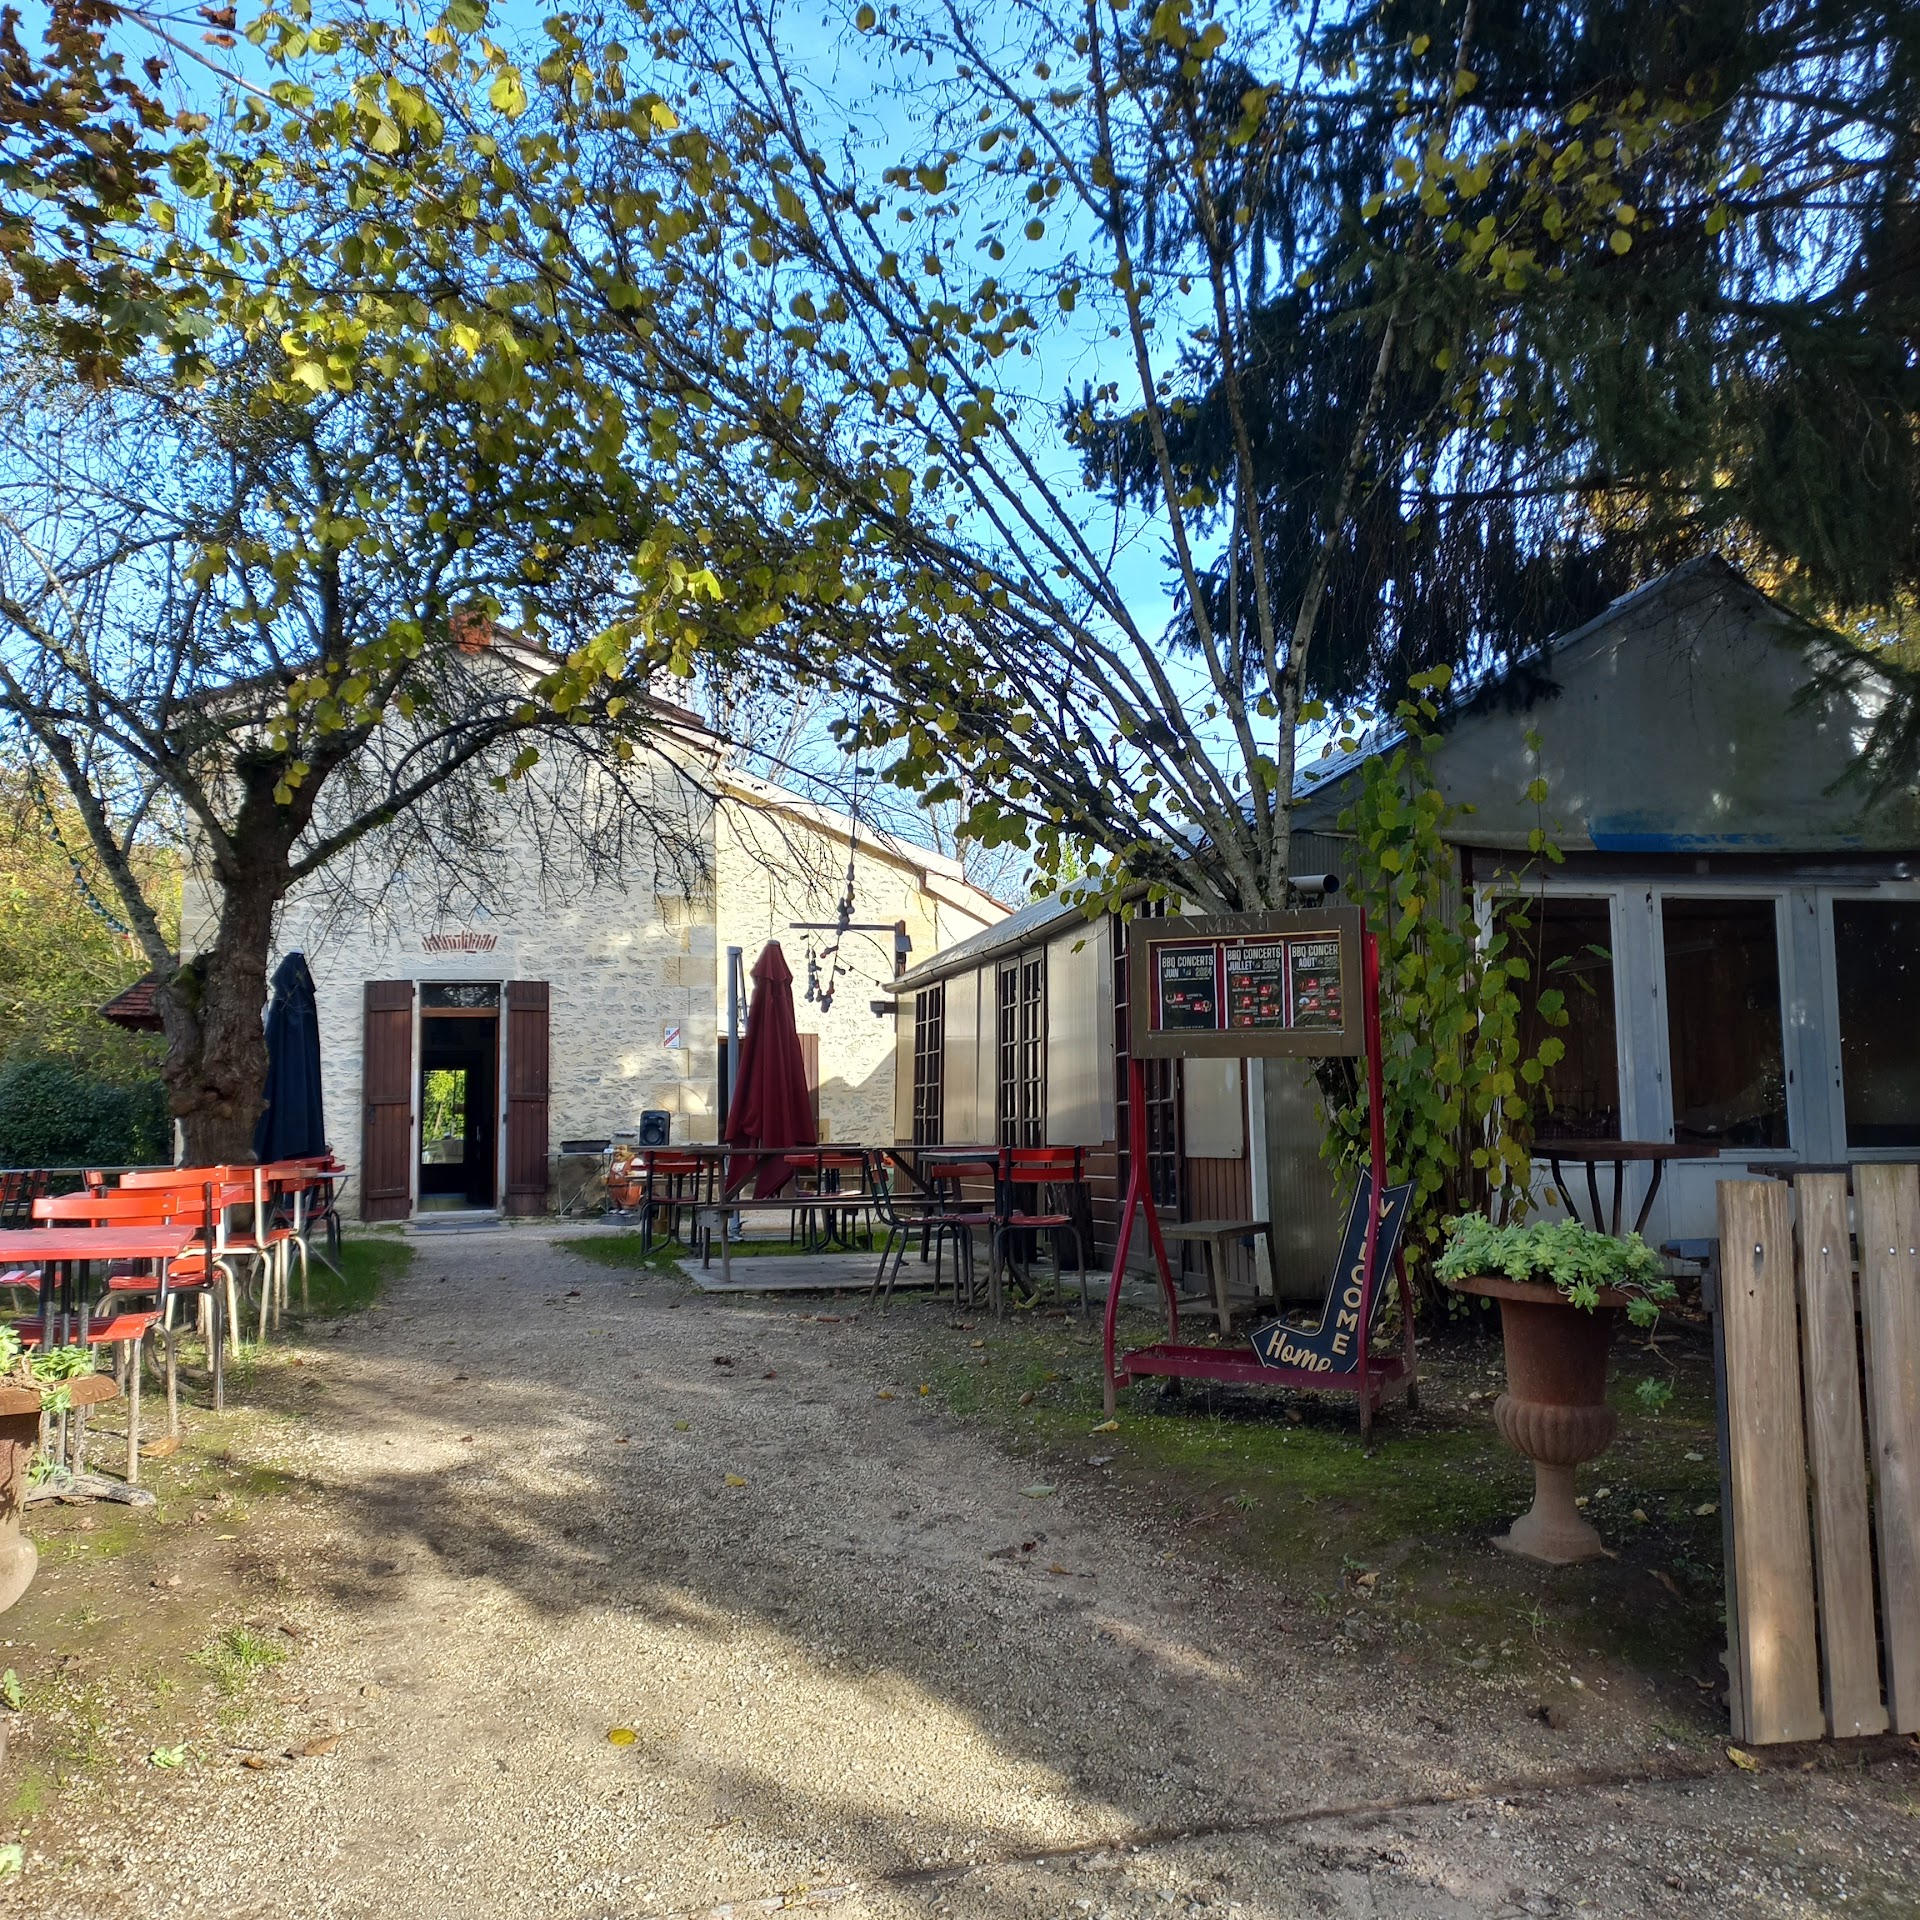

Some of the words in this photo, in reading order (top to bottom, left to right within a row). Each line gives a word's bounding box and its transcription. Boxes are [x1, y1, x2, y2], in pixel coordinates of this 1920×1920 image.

[1227, 950, 1241, 961] BBQ
[1243, 947, 1281, 960] CONCERTS
[1292, 946, 1306, 958] BBQ
[1308, 944, 1340, 957] CONCER
[1162, 956, 1176, 968] BBQ
[1177, 955, 1214, 968] CONCERTS
[1228, 960, 1253, 971] JUILLET
[1262, 959, 1280, 970] 2024
[1164, 968, 1179, 978] JUIN
[1195, 967, 1213, 977] 2024
[1266, 1330, 1334, 1373] Home
